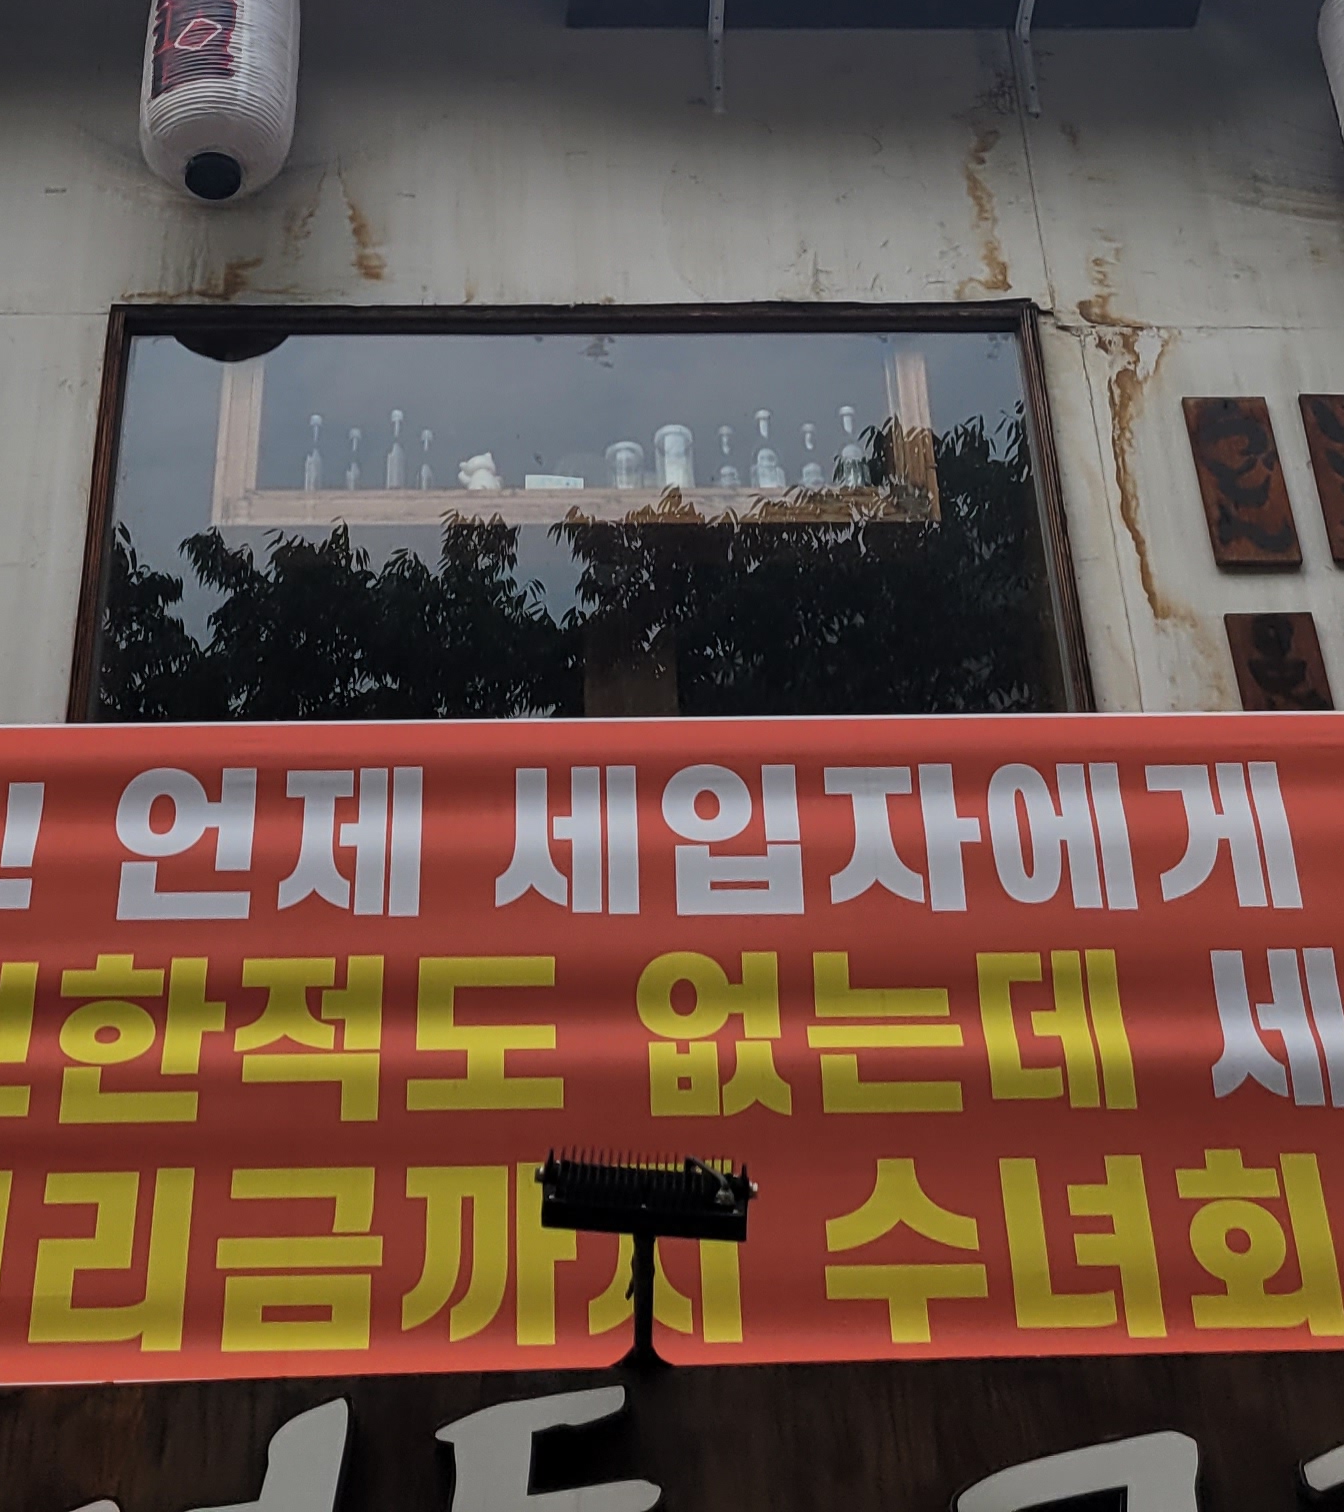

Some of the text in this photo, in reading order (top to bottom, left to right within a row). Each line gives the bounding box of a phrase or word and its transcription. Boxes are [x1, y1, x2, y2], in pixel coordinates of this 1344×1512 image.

[115, 766, 424, 921] 언제
[494, 761, 1304, 916] 세입자에게
[635, 949, 1139, 1117] 없는데
